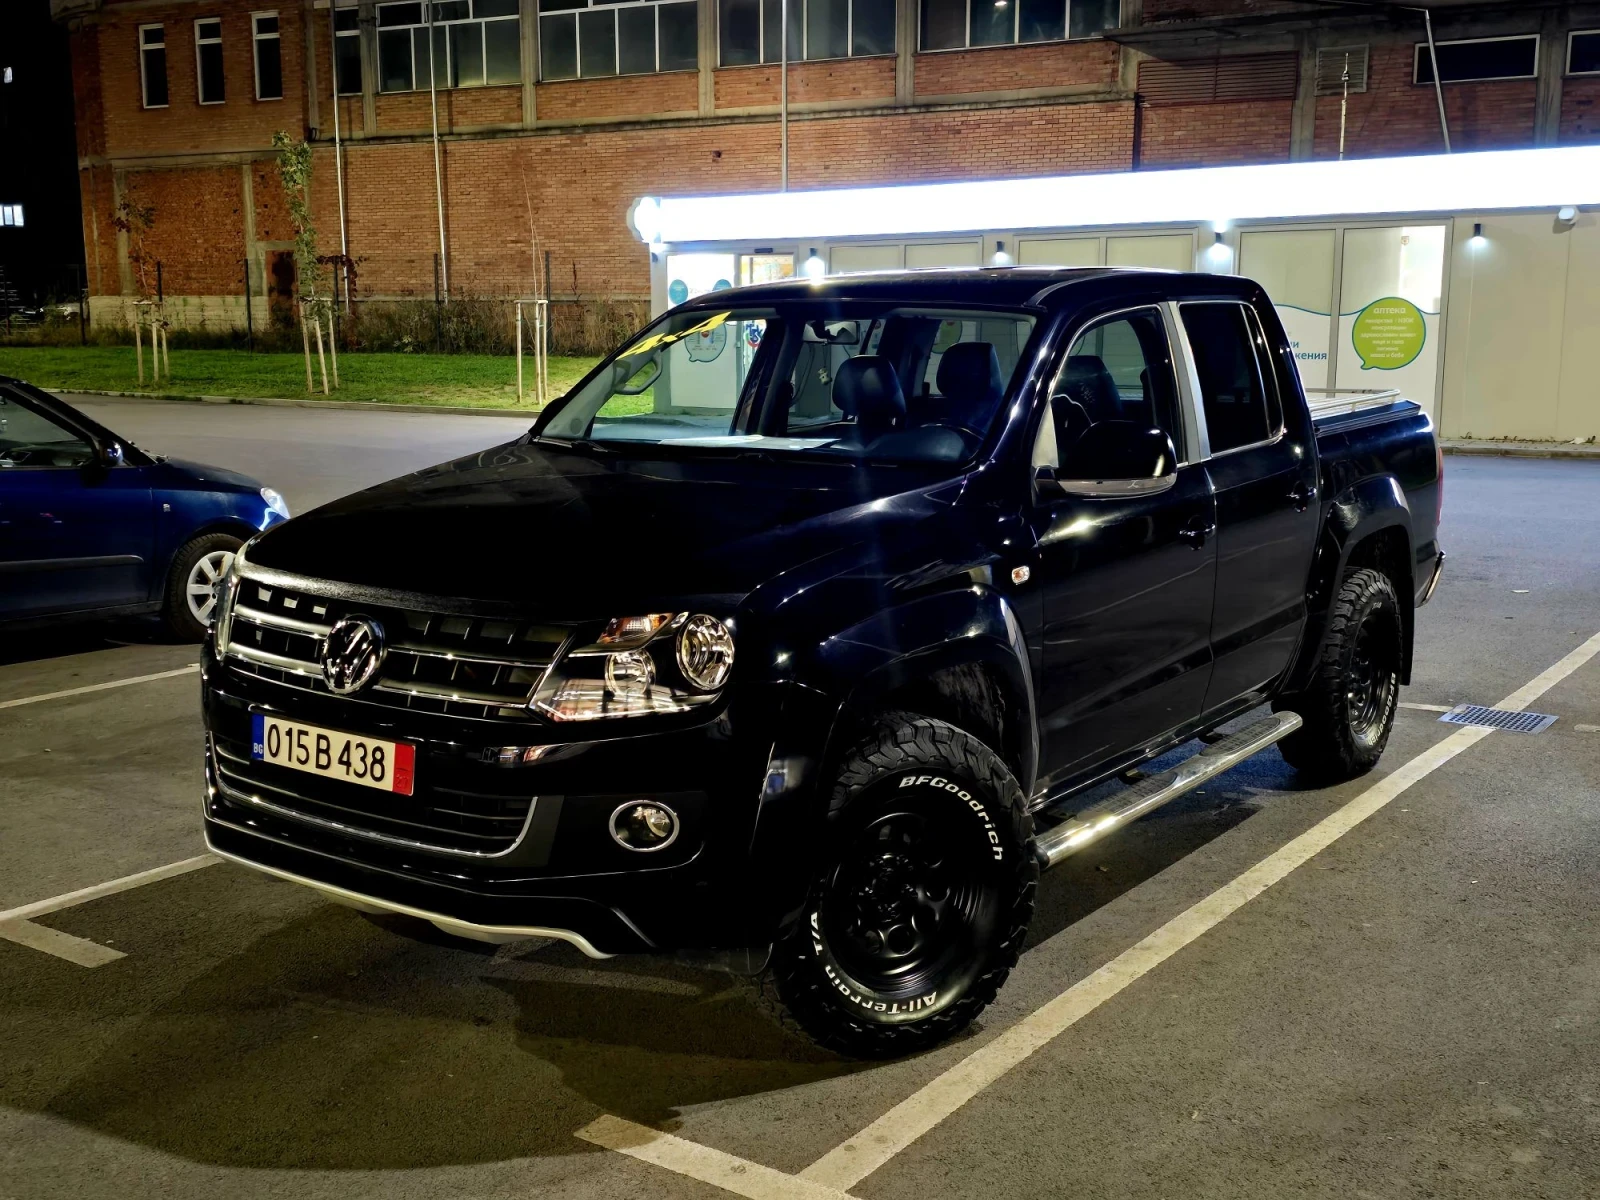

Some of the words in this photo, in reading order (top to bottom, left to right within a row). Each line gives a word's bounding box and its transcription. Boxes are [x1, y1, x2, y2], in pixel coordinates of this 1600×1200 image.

[1373, 307, 1406, 315] аптека
[253, 742, 263, 754] BG
[898, 775, 1004, 860] BFGoodrich
[810, 911, 823, 956] T/A
[824, 964, 938, 1015] All-Terrain
